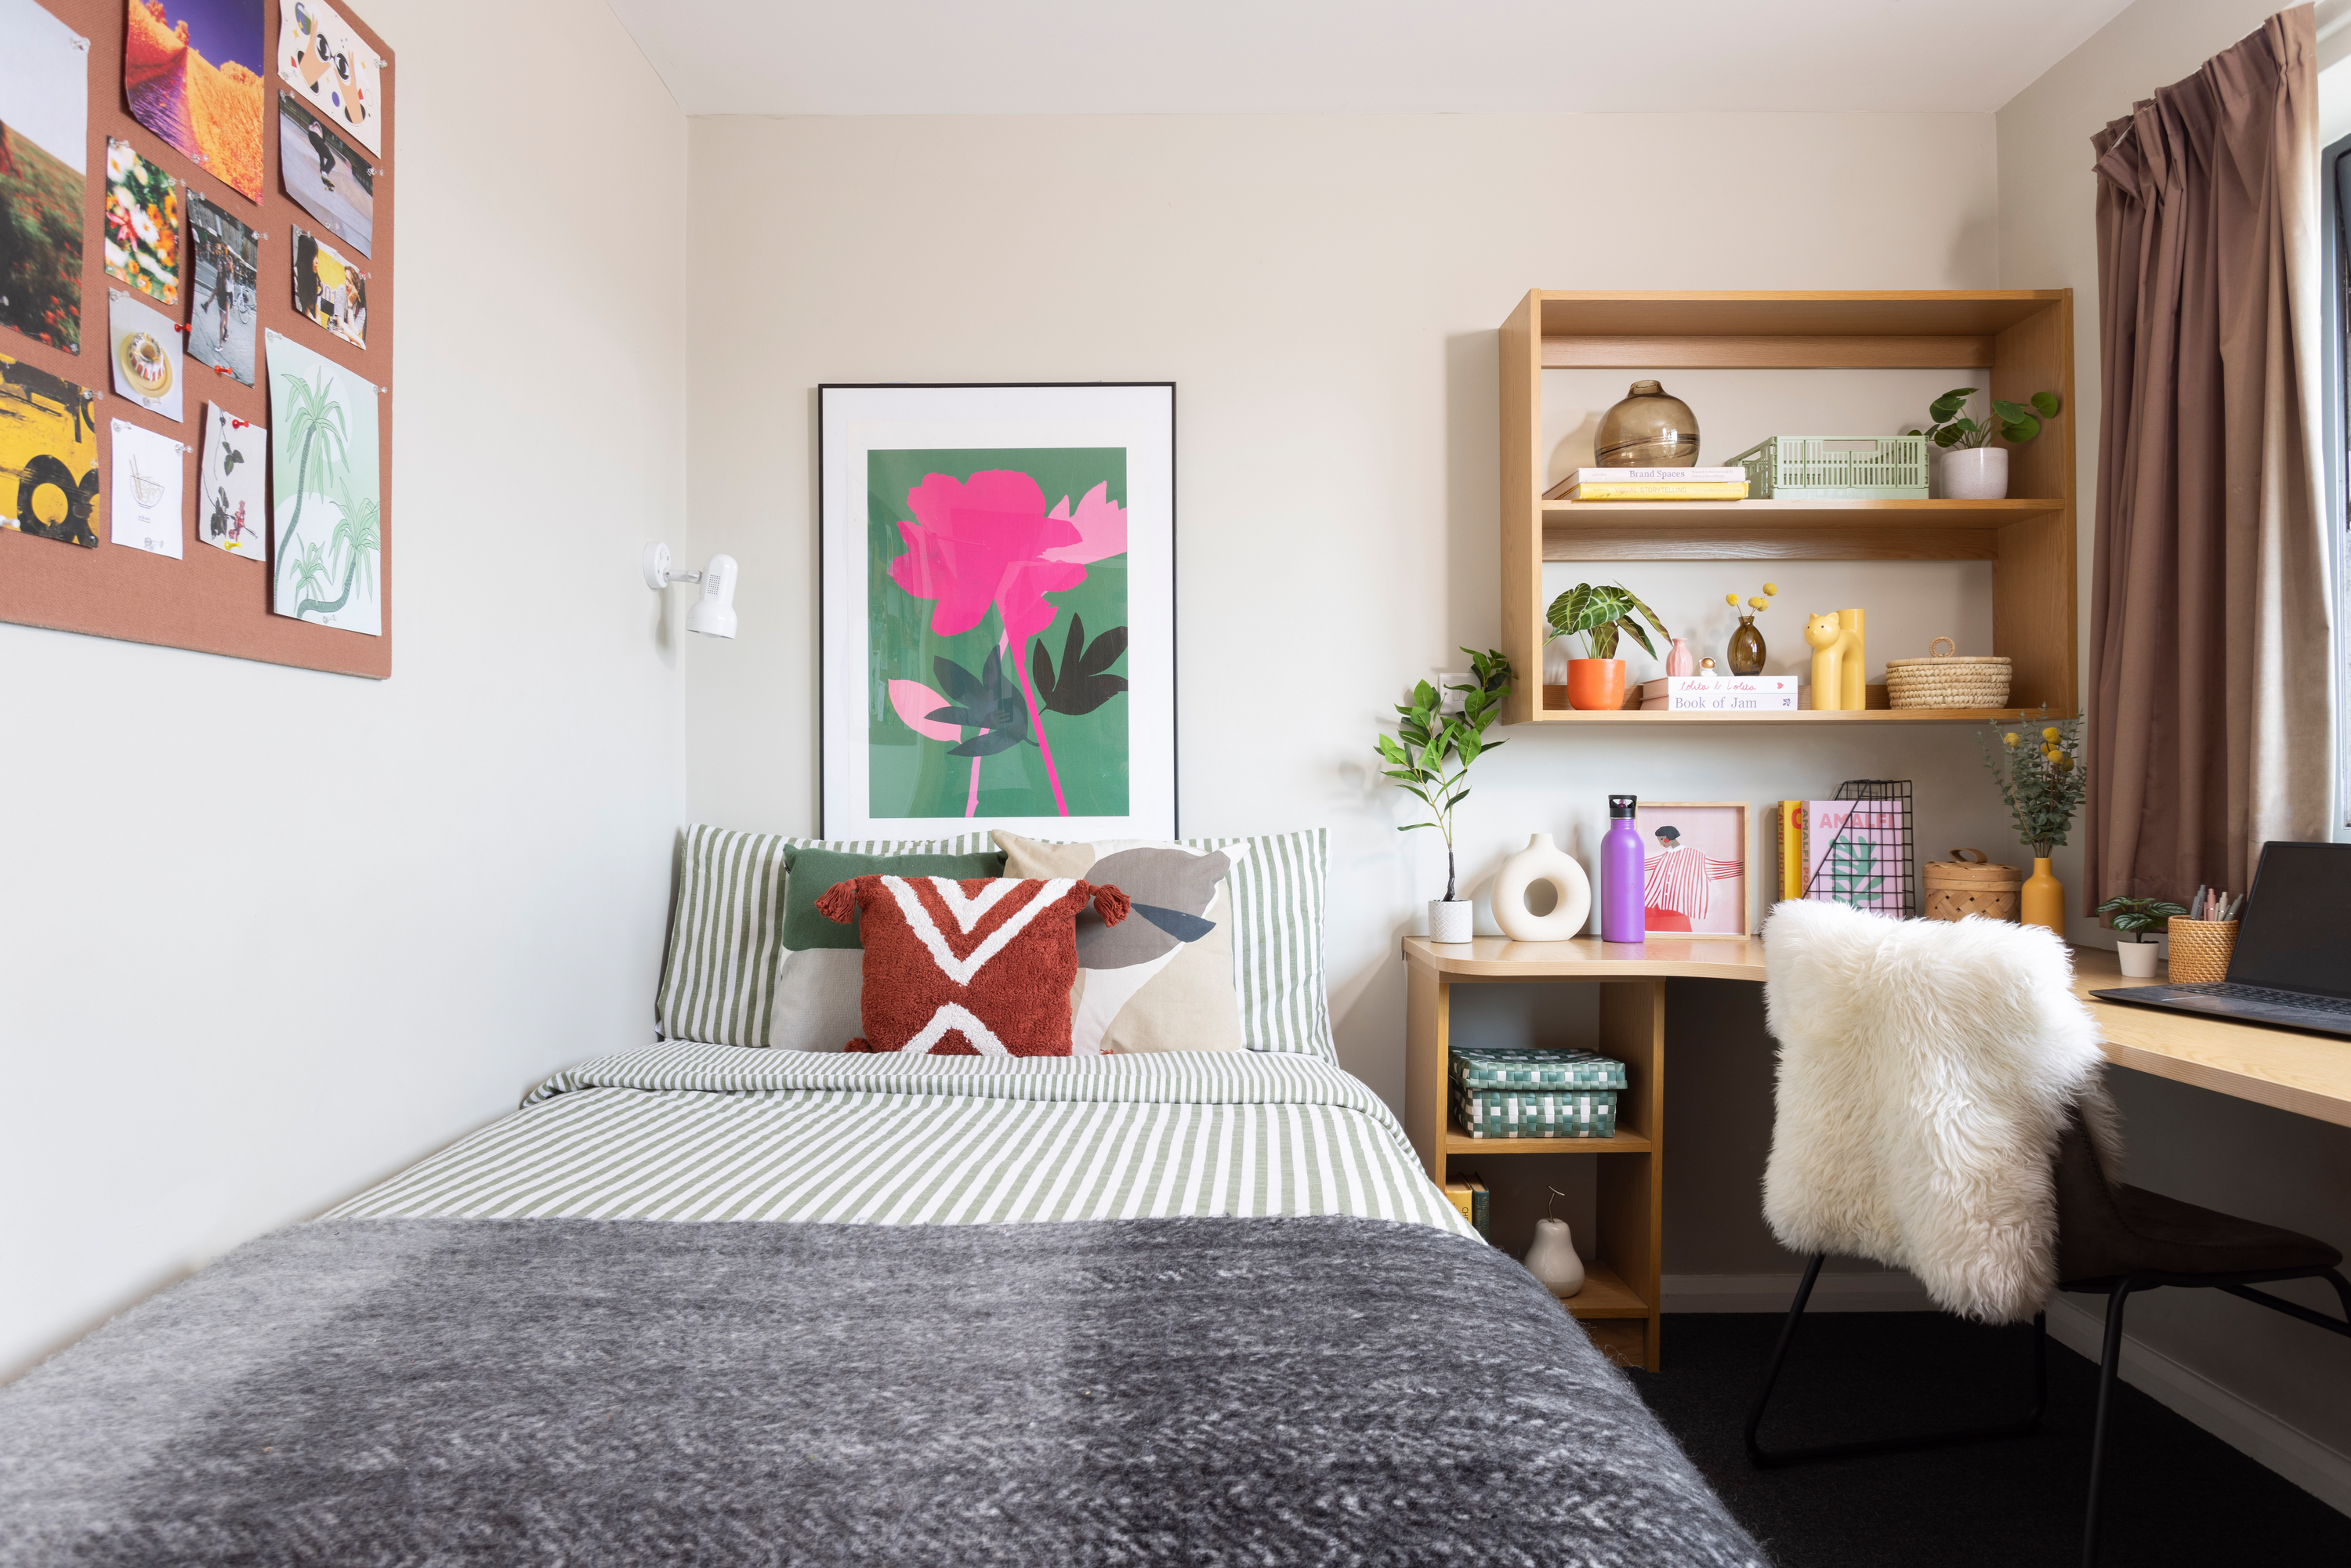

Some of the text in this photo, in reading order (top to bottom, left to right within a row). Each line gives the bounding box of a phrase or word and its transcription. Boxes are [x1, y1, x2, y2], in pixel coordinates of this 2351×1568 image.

[1657, 470, 1685, 480] Spaces
[1675, 697, 1757, 708] Book of Jam
[1819, 813, 1893, 829] AMALFI
